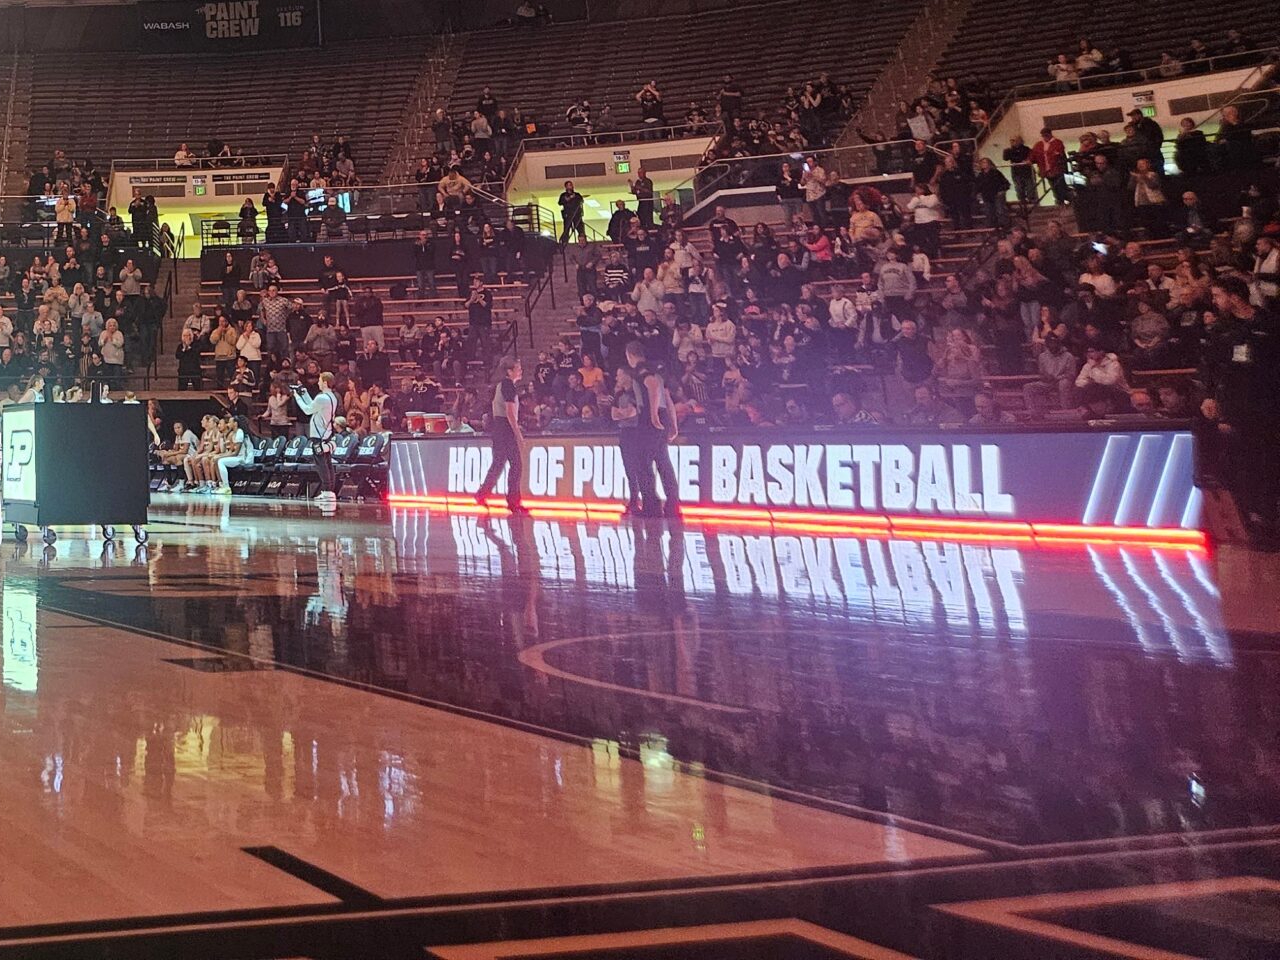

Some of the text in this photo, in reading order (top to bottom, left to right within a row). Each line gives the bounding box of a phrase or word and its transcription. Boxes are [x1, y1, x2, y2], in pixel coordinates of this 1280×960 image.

[204, 0, 259, 21] PAINT
[277, 12, 303, 27] 116
[143, 21, 190, 30] WABASH
[205, 19, 259, 39] CREW
[7, 429, 33, 482] P
[529, 446, 564, 496] OF
[573, 445, 701, 502] PUE
[711, 444, 1015, 514] BASKETBALL
